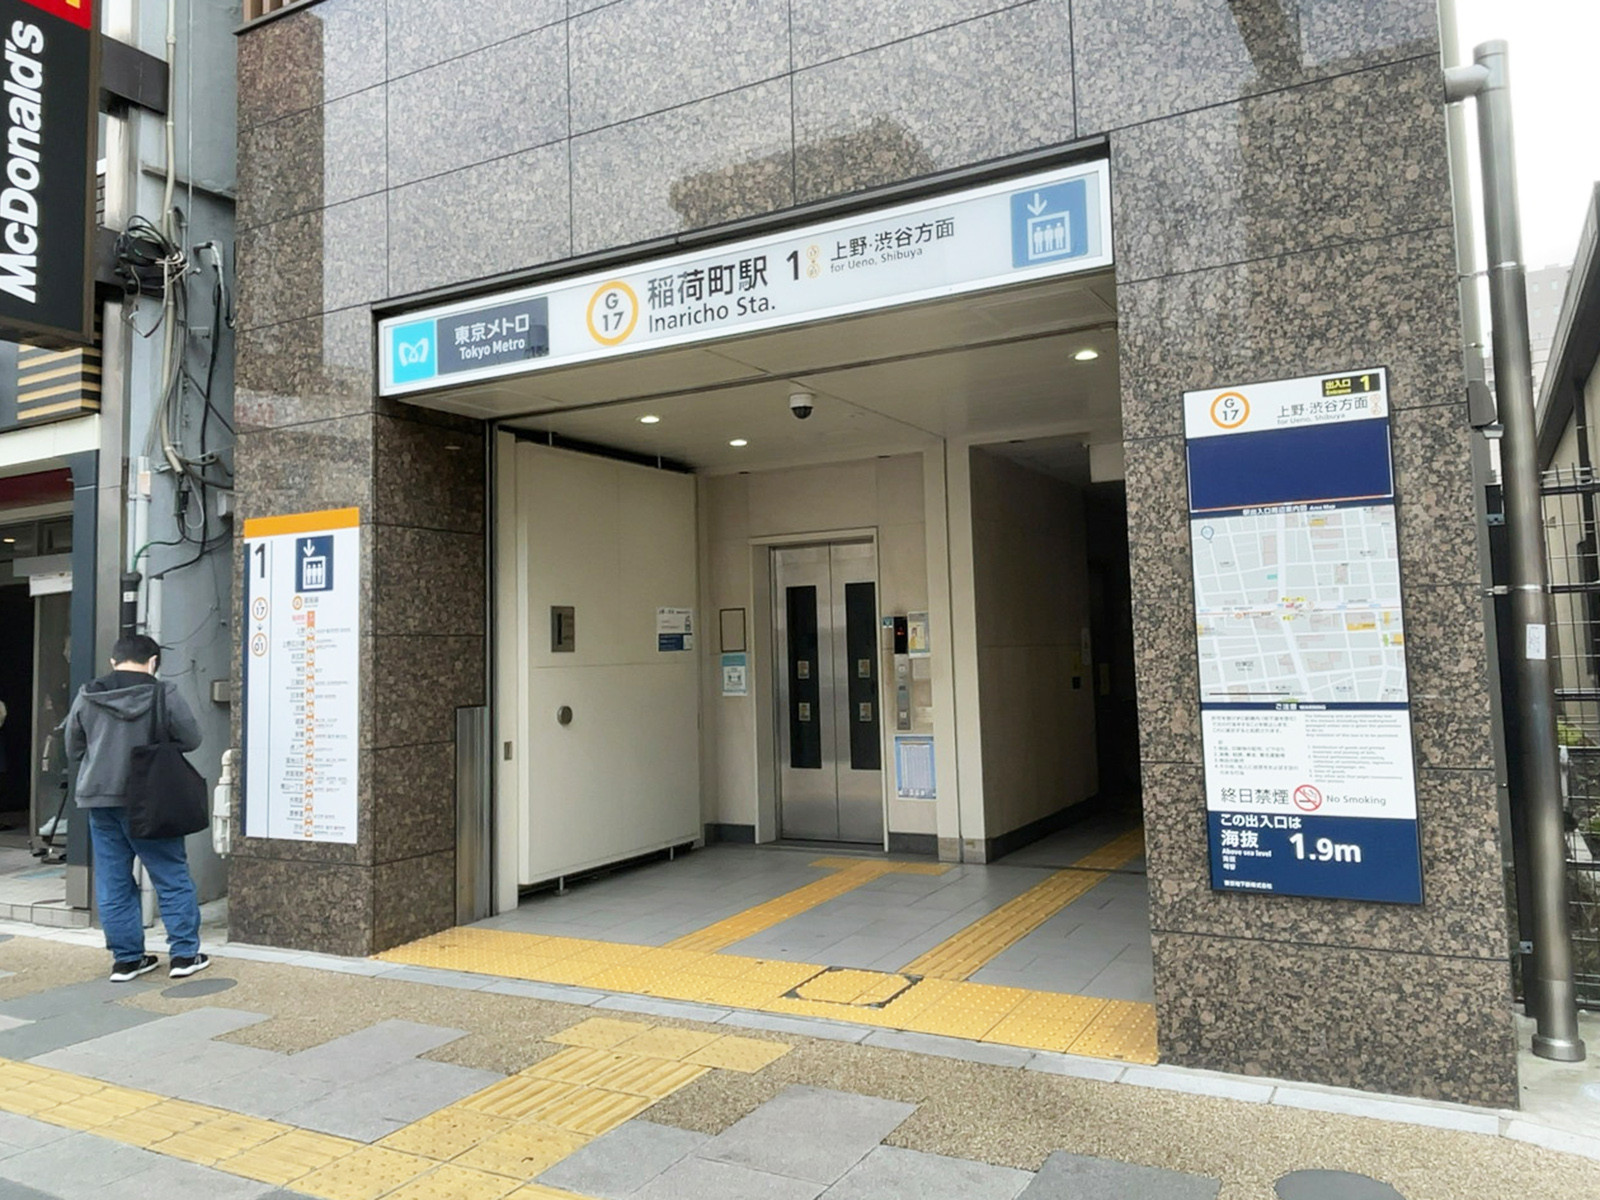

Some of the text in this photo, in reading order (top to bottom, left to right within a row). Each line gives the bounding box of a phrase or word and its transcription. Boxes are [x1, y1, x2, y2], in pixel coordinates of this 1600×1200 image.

[0, 20, 44, 304] McDonald's
[786, 250, 799, 281] 1
[830, 247, 923, 273] for Ueno, Shibuya
[648, 255, 768, 310] 稲荷町駅
[605, 292, 619, 309] G
[602, 311, 624, 331] 17
[649, 296, 776, 333] Inaricho Sta.
[454, 314, 530, 345] 東京メトロ
[459, 337, 525, 361] Tokyo Metro
[1325, 375, 1370, 391] 出入口 1
[1225, 398, 1235, 408] G
[1222, 409, 1239, 421] 17
[1315, 413, 1346, 422] Shibuya
[255, 543, 265, 578] 1
[1221, 787, 1387, 806] 終日禁煙 No Smoking
[1221, 813, 1302, 829] この出入口は
[1221, 829, 1362, 863] 海抜 1.9m
[1222, 848, 1242, 856] Above
[1255, 850, 1272, 858] level
